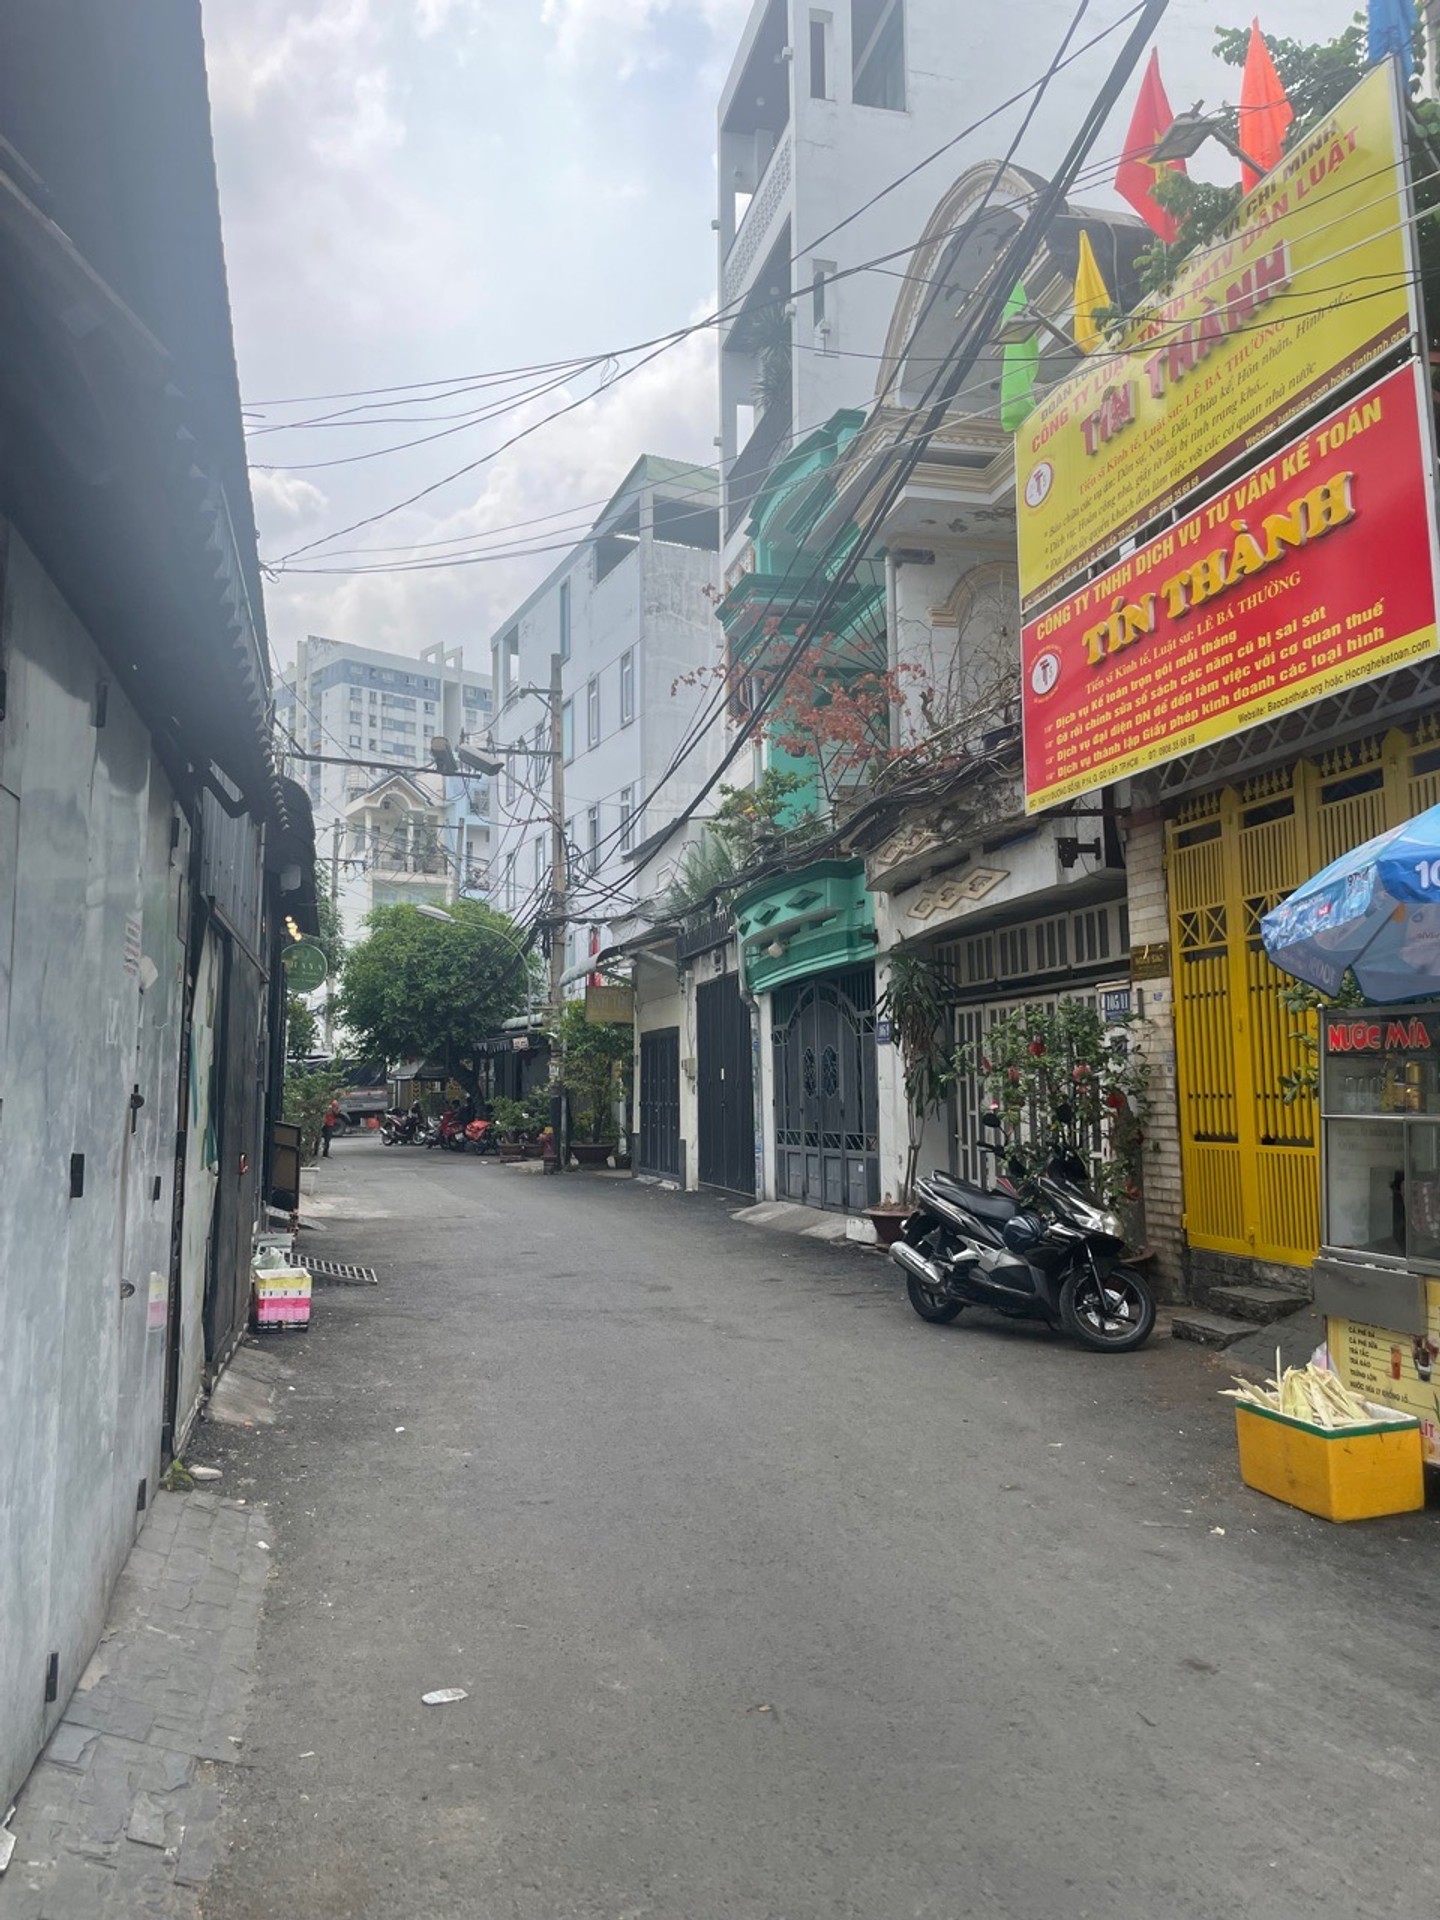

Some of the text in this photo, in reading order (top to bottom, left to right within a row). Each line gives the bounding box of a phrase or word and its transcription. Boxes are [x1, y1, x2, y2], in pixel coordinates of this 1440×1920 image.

[1246, 175, 1275, 219] CHÍ
[1282, 118, 1336, 184] MINH
[1031, 405, 1068, 455] CÔNG
[1072, 384, 1088, 415] TY
[1192, 243, 1234, 300] MTV
[1241, 190, 1288, 253] DÂN
[1296, 123, 1358, 203] LUẬT
[1143, 232, 1292, 410] THÀNH
[1106, 444, 1128, 473] Kinh
[1143, 413, 1165, 445] Luật
[1166, 400, 1182, 423] sư:
[1184, 380, 1201, 409] LÊ
[1205, 363, 1221, 392] BÁ
[1226, 309, 1285, 375] THƯỜNG
[1190, 416, 1208, 443] tình
[1211, 394, 1237, 430] trạng
[1193, 389, 1217, 421] Thừa
[1237, 355, 1258, 386] Hôn
[1261, 328, 1292, 368] nhân,
[1204, 428, 1220, 454] các
[1236, 400, 1261, 433] quan
[1264, 379, 1285, 408] nhà
[1288, 355, 1316, 391] nước
[1036, 603, 1071, 642] CÔNG
[1074, 590, 1090, 617] TY
[1093, 561, 1131, 604] TNHH
[1135, 533, 1174, 581] DỊCH
[1179, 514, 1201, 553] VỤ
[1205, 492, 1231, 531] TƯ
[1234, 465, 1275, 512] VẤN
[1281, 435, 1310, 482] KẾ
[1316, 395, 1381, 459] TOÁN
[1081, 587, 1157, 672] TÍN
[1160, 465, 1356, 625] THÀNH
[1056, 709, 1075, 731] Dịch
[1078, 705, 1088, 720] vụ
[1091, 693, 1104, 712] Kế
[1106, 683, 1127, 704] toán
[1130, 671, 1151, 694] trọn
[1154, 660, 1172, 681] gói
[1201, 626, 1237, 658] tháng
[1057, 742, 1077, 763] Dịch
[1079, 738, 1090, 753] vụ
[1092, 728, 1107, 747] đại
[1110, 716, 1132, 739] diện
[1135, 708, 1150, 726] DN
[1170, 687, 1192, 710] đến
[1196, 676, 1218, 698] làm
[1222, 661, 1250, 688] việc
[1254, 649, 1275, 672] với
[1279, 640, 1298, 660] cơ
[1302, 621, 1341, 651] quan
[1345, 596, 1385, 630] thuế
[1085, 674, 1104, 696] Tiến
[1114, 657, 1137, 680] Kinh
[1139, 648, 1151, 669] tế,
[1153, 636, 1176, 661] Luật
[1177, 628, 1193, 647] sư:
[1196, 614, 1213, 636] LÊ
[1216, 603, 1234, 626] BÁ
[1238, 566, 1300, 615] THƯỜNG
[1150, 676, 1177, 700] sách
[1180, 664, 1202, 686] các
[1205, 648, 1233, 674] năm
[1237, 638, 1253, 659] cũ
[1257, 630, 1271, 652] bị
[1275, 617, 1297, 641] sai
[1301, 603, 1325, 628] sót
[1238, 702, 1264, 725] Website:
[1324, 670, 1343, 692] hoặc
[1344, 633, 1430, 684] Hocngheketoan.com
[1057, 623, 1383, 780] Dịch vụ thành lập Giấy phép kinh doanh các loại hình
[1328, 1016, 1431, 1052] NƯỚC MÍA
